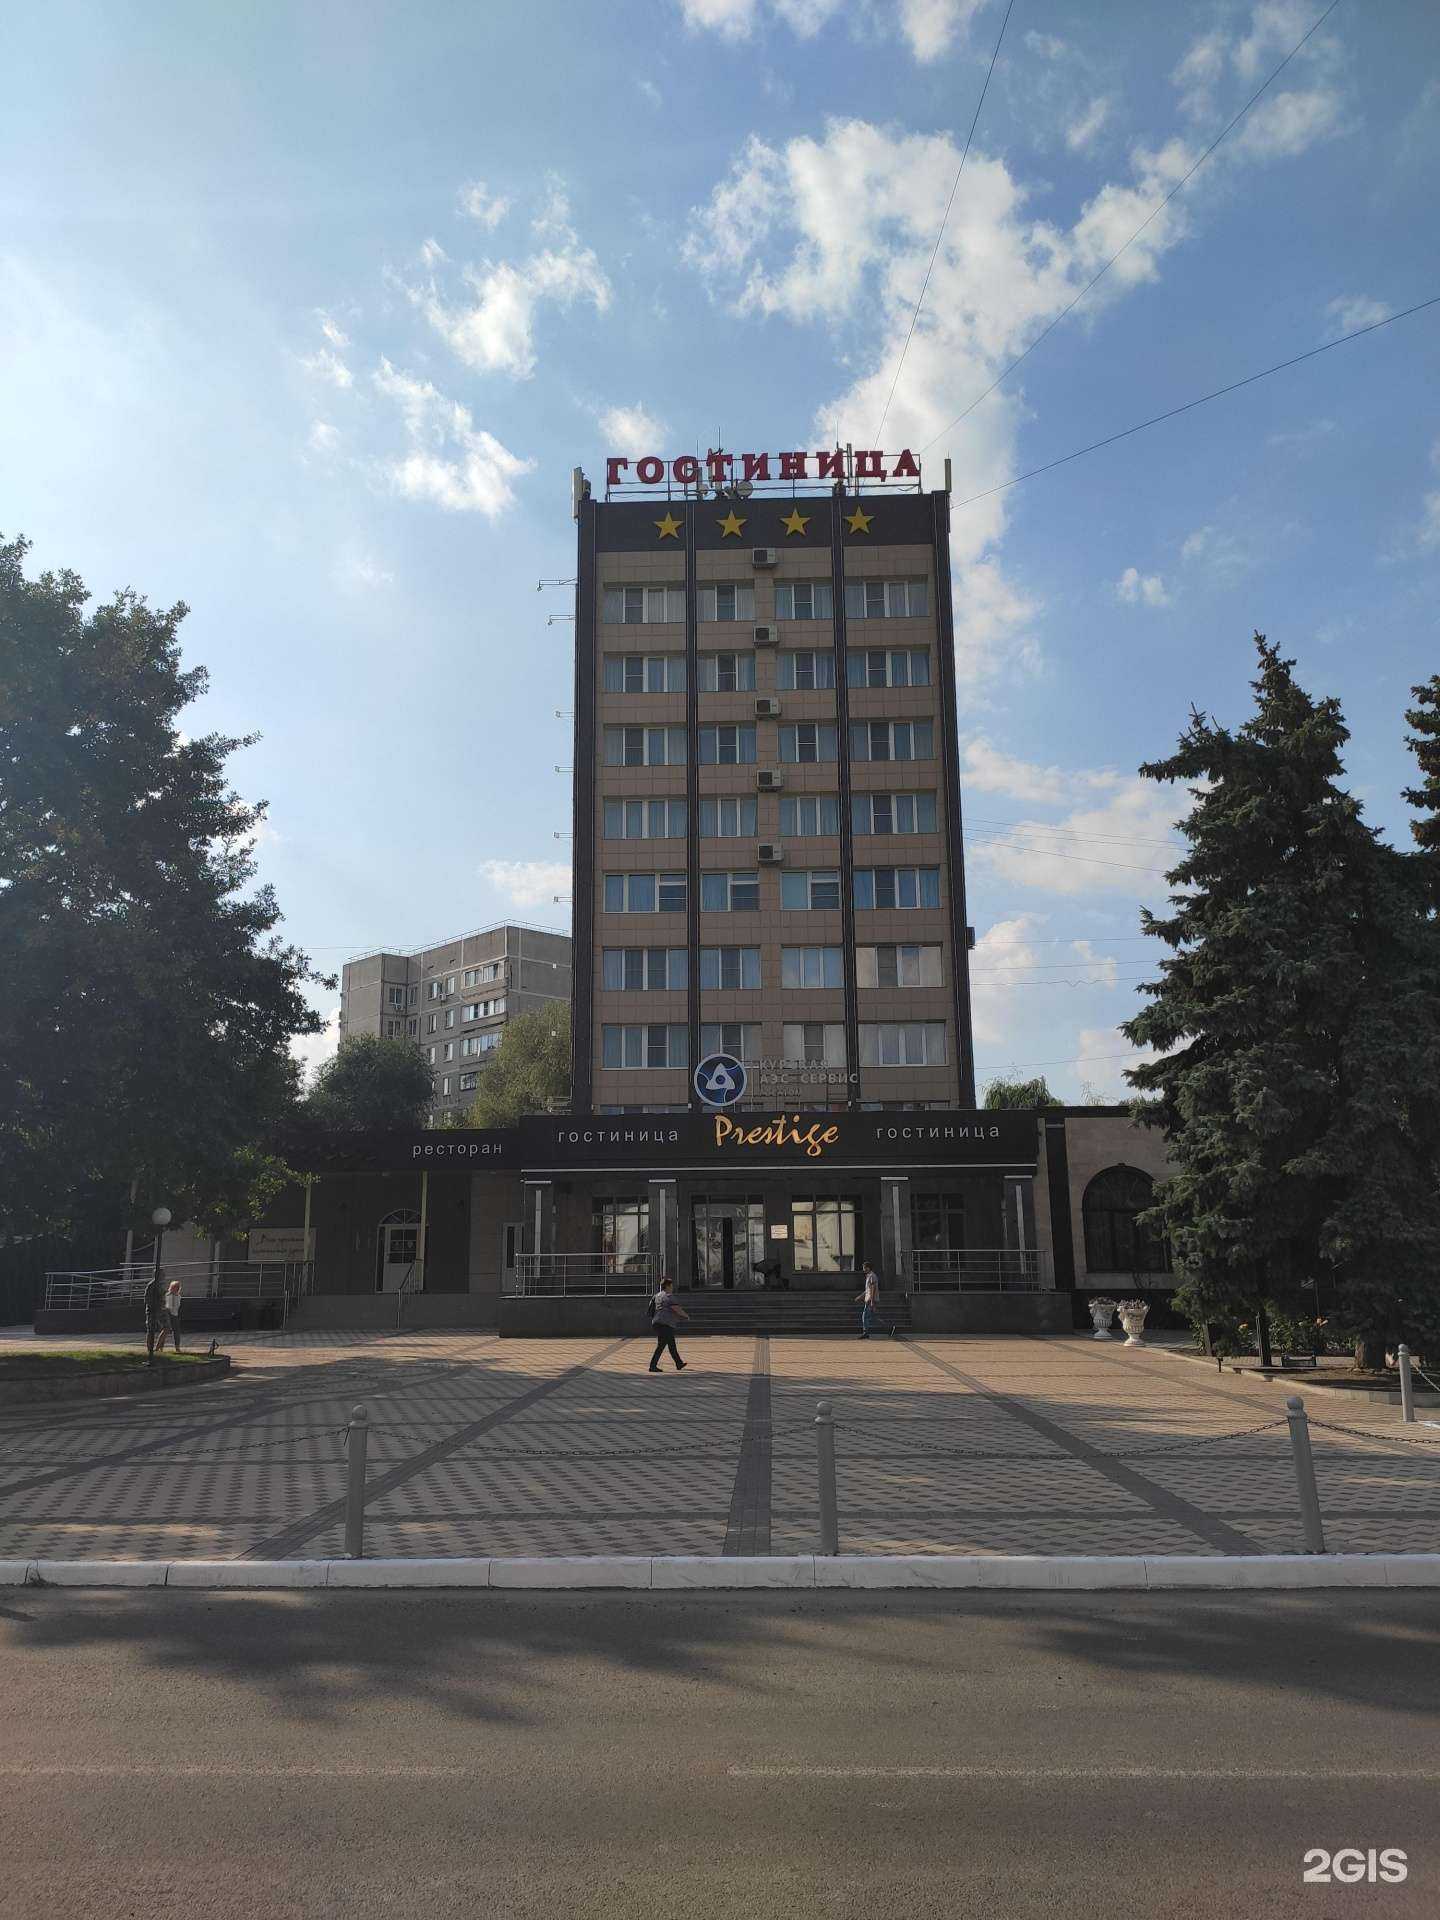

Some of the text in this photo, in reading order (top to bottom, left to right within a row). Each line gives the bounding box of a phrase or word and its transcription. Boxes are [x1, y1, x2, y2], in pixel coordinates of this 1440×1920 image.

[607, 448, 921, 484] ГОСТИНИЦА
[557, 1128, 679, 1144] гостиница
[714, 1114, 840, 1157] Prestige
[876, 1126, 1000, 1141] гостиница
[412, 1142, 502, 1158] ресторан
